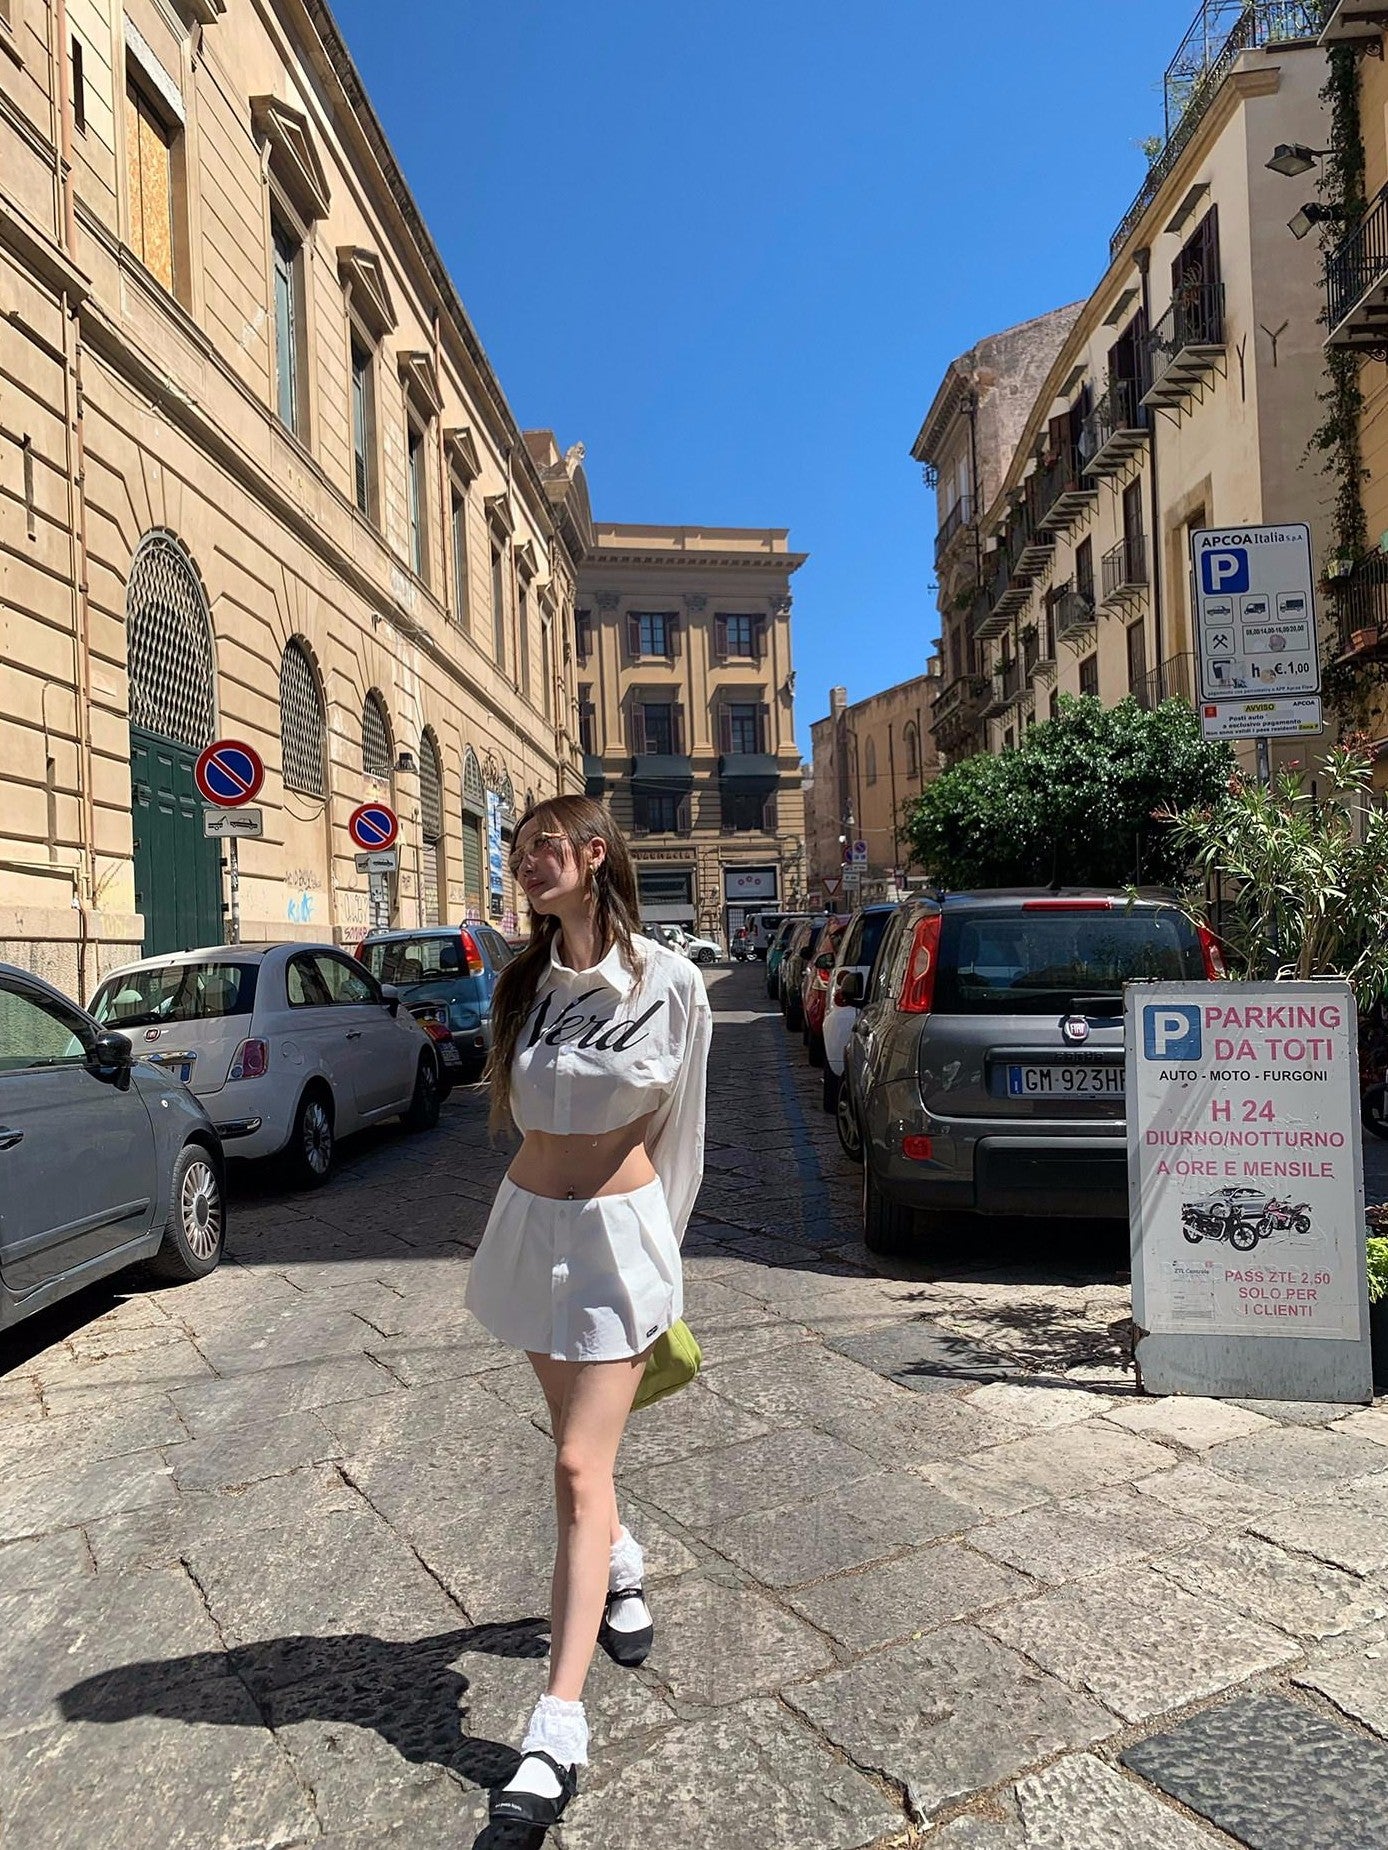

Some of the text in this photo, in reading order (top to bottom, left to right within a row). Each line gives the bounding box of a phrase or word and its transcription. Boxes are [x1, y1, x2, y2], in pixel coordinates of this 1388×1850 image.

[1202, 534, 1252, 548] APCOA
[1254, 532, 1284, 544] Italia
[1210, 554, 1240, 590] P
[1252, 663, 1260, 678] h
[1245, 704, 1275, 712] AVVISO
[526, 986, 666, 1052] Verd
[1070, 1024, 1086, 1034] FIAT
[1154, 1006, 1341, 1054] P PARKING
[1215, 1038, 1333, 1060] DA TOTI
[1026, 1069, 1052, 1091] GM
[1159, 1070, 1197, 1081] AUTO
[1210, 1070, 1250, 1081] MOTO
[1263, 1070, 1327, 1081] FURGONI
[1212, 1100, 1276, 1122] H 24
[1146, 1131, 1344, 1147] DIURNO/NOTTURNO
[1157, 1161, 1333, 1178] A ORE E MENSILE
[1225, 1270, 1264, 1282] PASS
[1269, 1271, 1296, 1283] ZTL
[1239, 1288, 1317, 1300] SOLO PER
[1244, 1304, 1312, 1317] I CLIENTI
